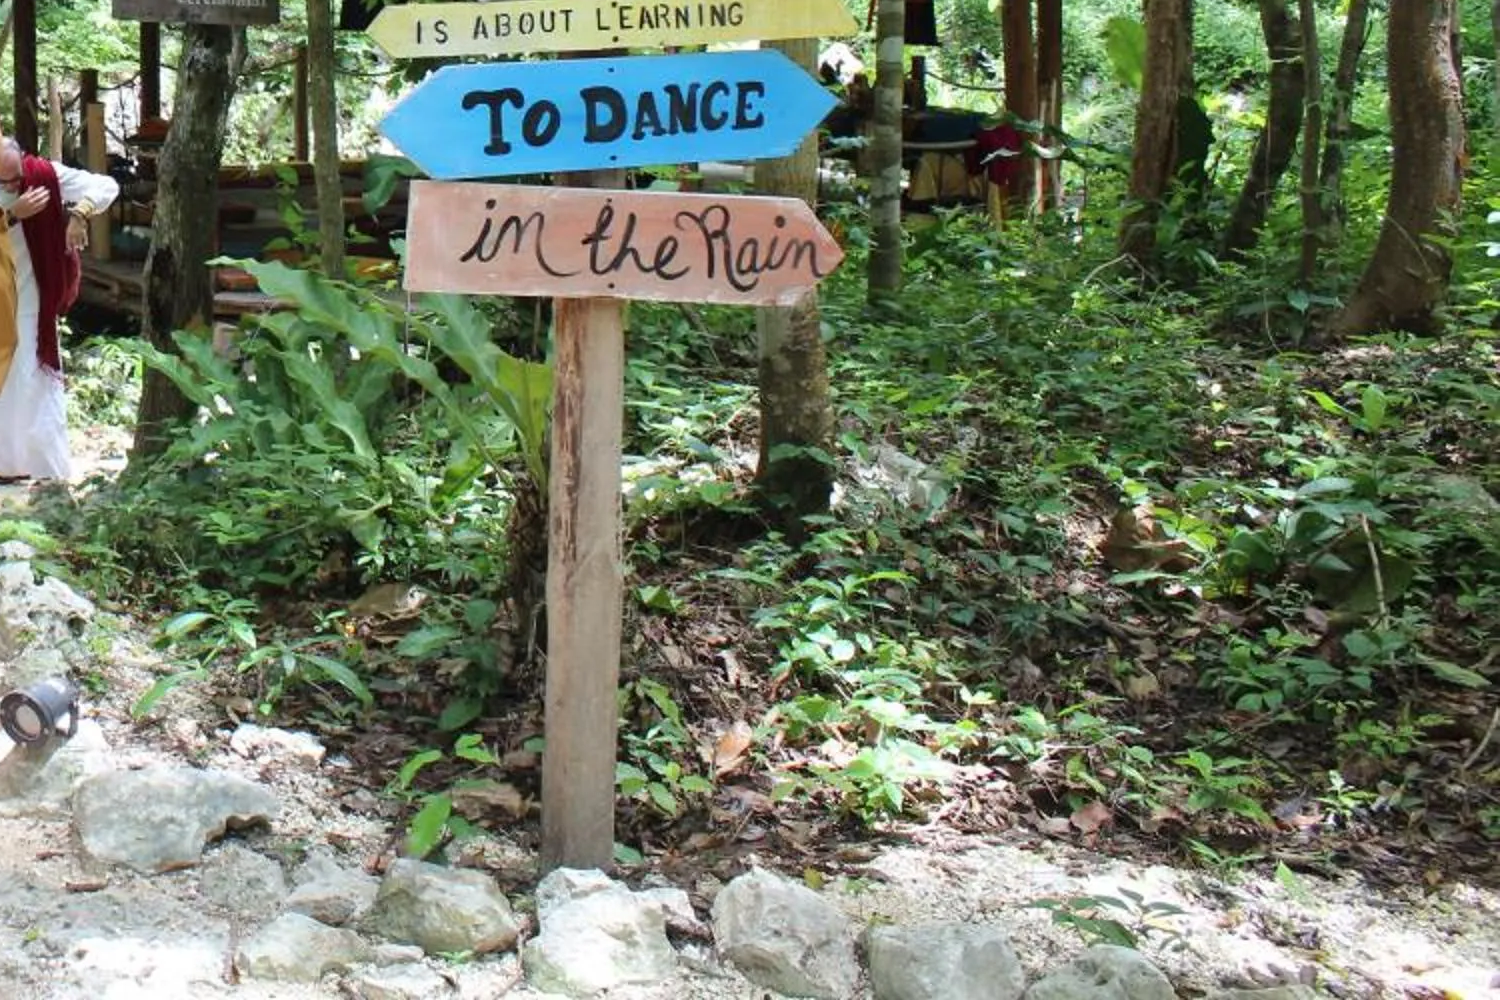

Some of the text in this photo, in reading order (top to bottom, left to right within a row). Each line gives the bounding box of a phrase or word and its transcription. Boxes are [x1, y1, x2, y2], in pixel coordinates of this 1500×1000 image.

[416, 1, 744, 44] IS ABOUT LEARNING
[580, 81, 765, 145] DANCE
[460, 199, 834, 292] in the Rain
